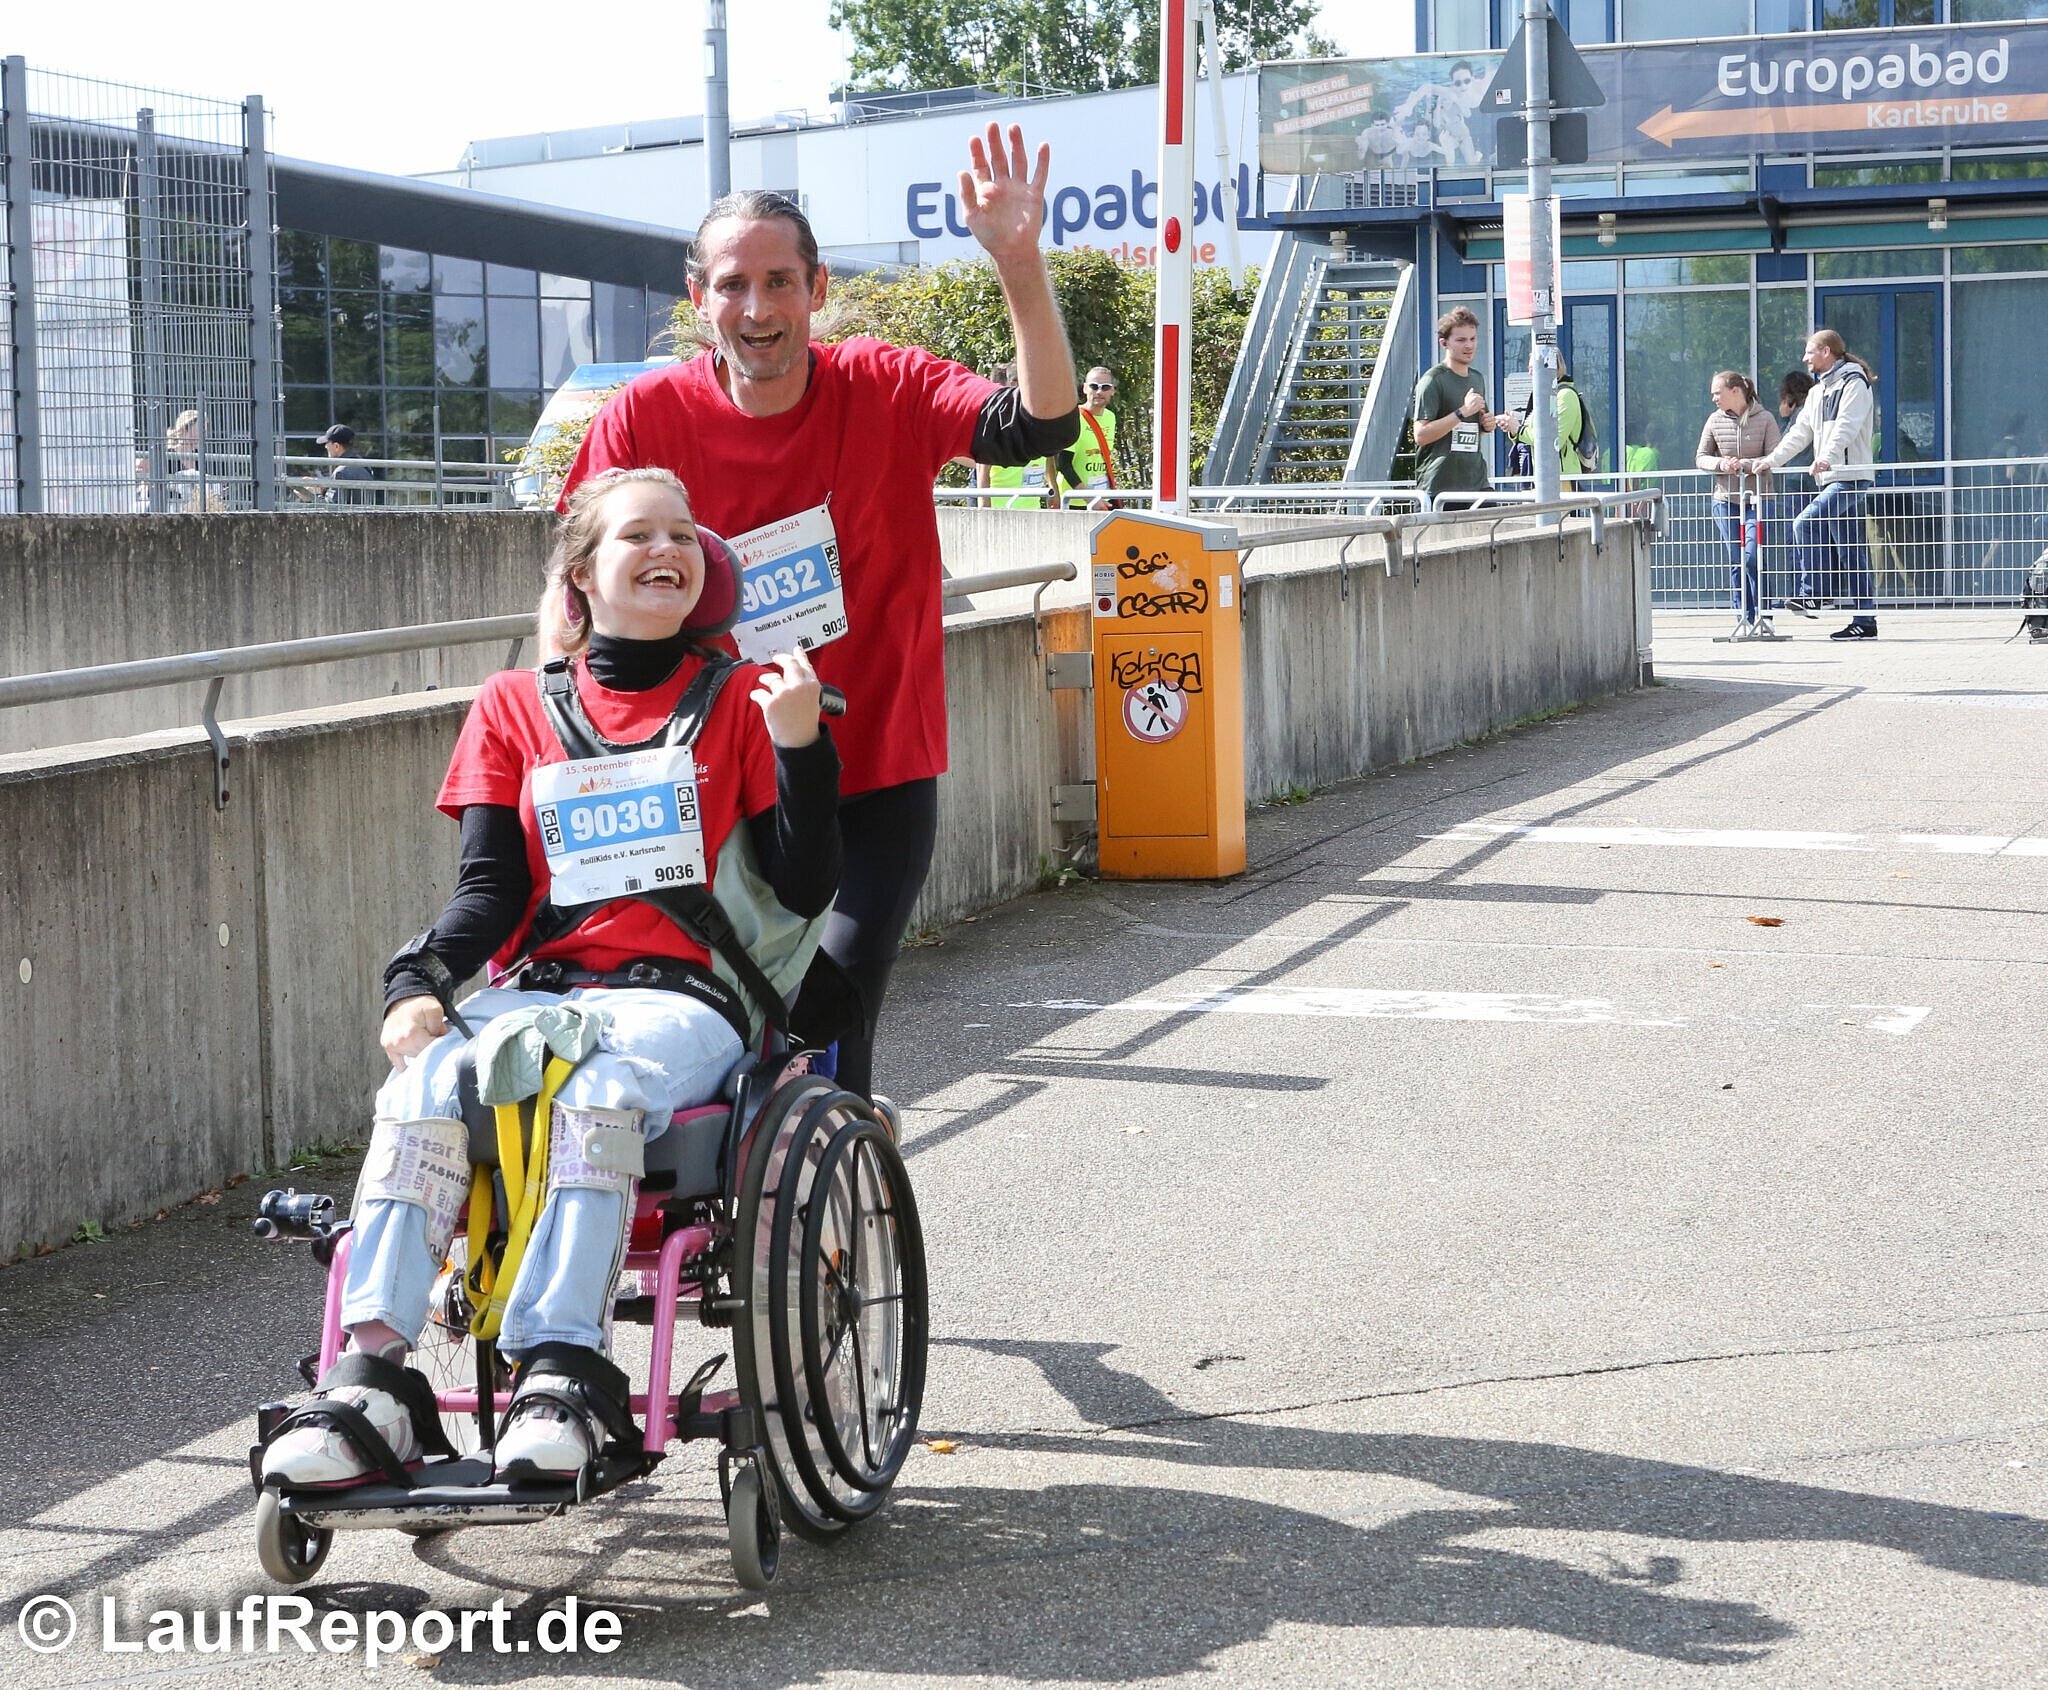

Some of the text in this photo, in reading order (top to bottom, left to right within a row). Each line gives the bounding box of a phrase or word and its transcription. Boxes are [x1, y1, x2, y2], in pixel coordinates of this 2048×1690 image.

[1717, 38, 2009, 100] Europabad
[1866, 98, 2008, 128] Karlsruhe
[733, 529, 778, 551] September
[779, 520, 800, 534] 2024
[743, 559, 822, 612] 9032
[755, 602, 827, 632] RolliKids e.V. Karlsruhe
[822, 616, 846, 637] 9032
[566, 767, 579, 775] 15.
[582, 760, 633, 774] September
[570, 796, 665, 841] 9036
[580, 845, 666, 866] RolliKids e.V. Karlsruhe
[655, 864, 694, 882] 9036
[406, 1135, 456, 1159] star
[413, 1171, 425, 1192] star
[436, 1187, 448, 1208] HOT
